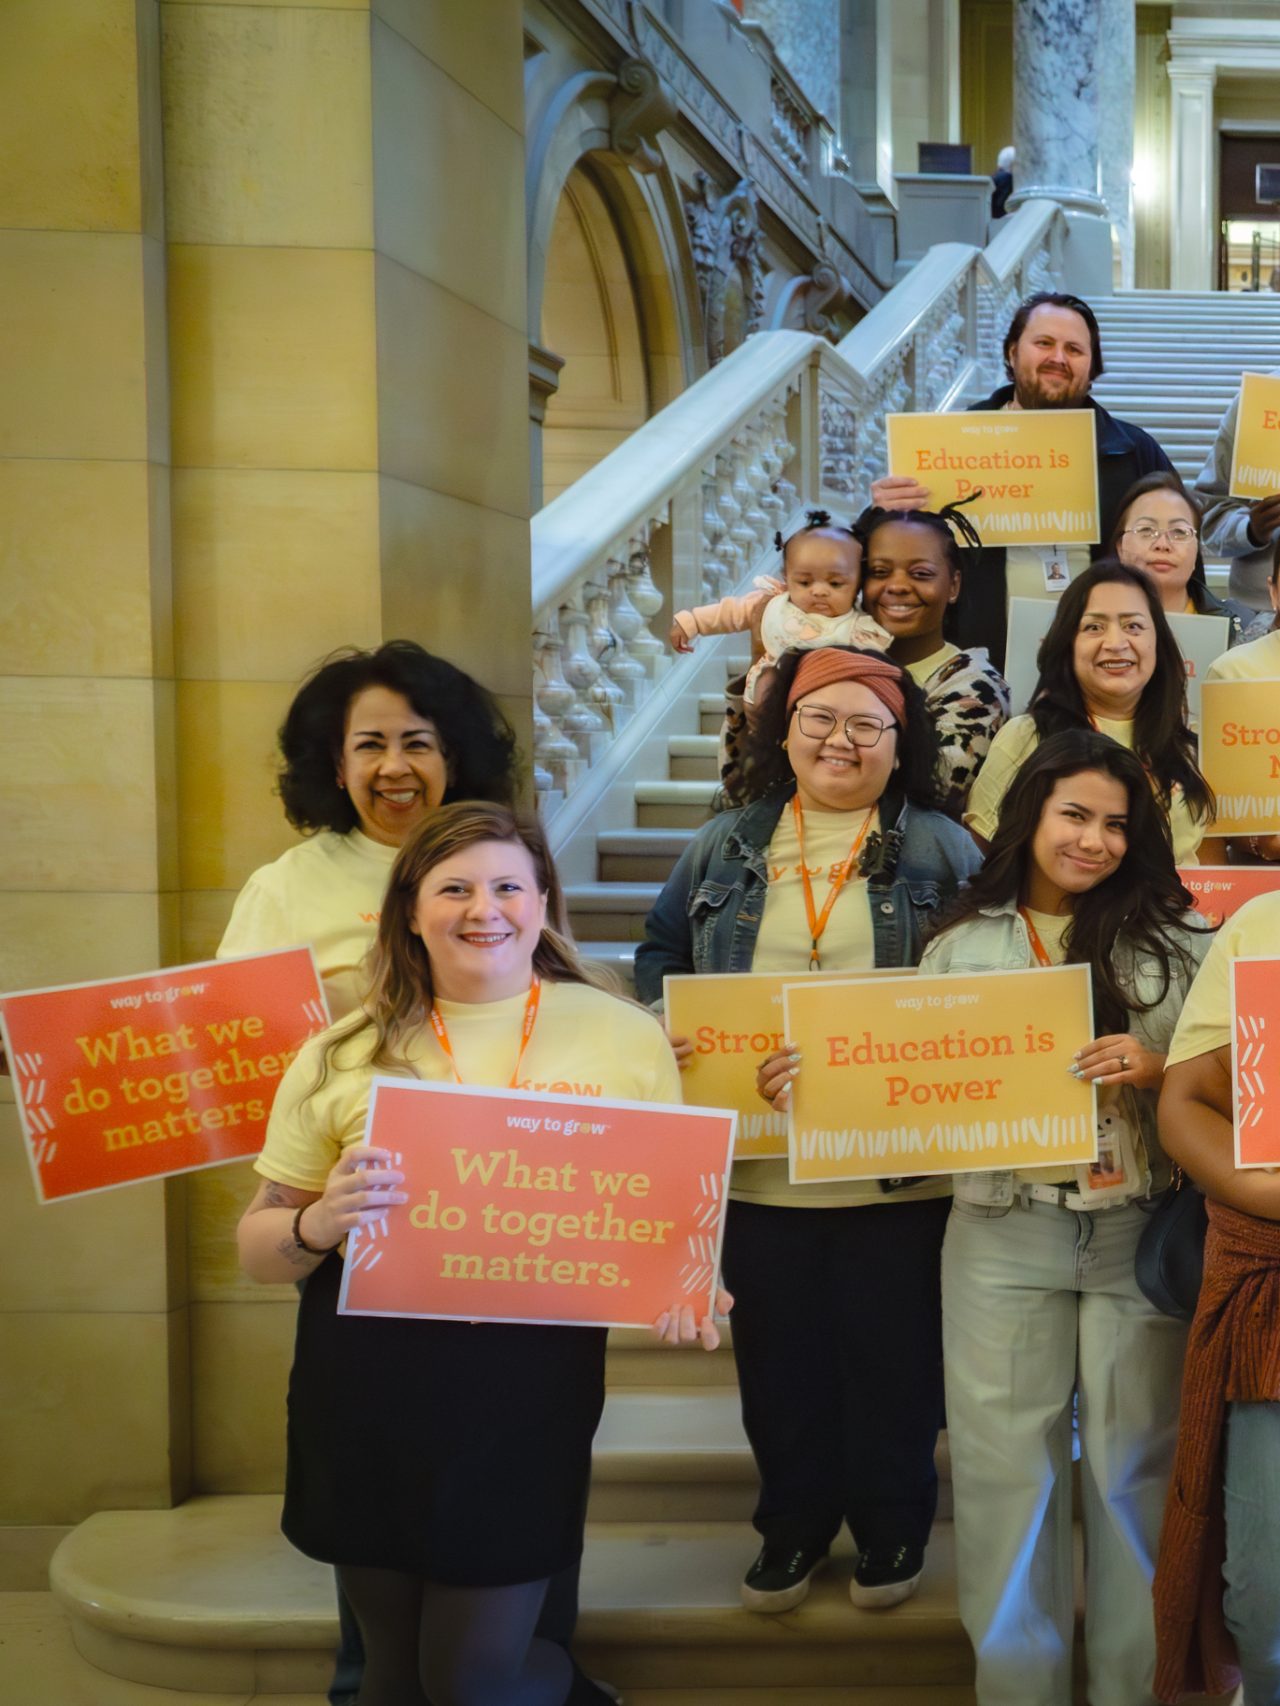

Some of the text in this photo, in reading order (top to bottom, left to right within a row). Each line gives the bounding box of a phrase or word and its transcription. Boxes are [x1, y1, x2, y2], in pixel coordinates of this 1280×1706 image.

[916, 448, 1070, 471] Education is
[956, 479, 1034, 500] Power
[1190, 881, 1201, 891] to
[1203, 881, 1232, 893] grow
[110, 982, 205, 1010] way to grow
[895, 993, 980, 1011] way to grow
[75, 1016, 265, 1069] What we
[695, 1026, 785, 1055] Stron
[826, 1024, 1056, 1067] Education is
[63, 1048, 299, 1116] do together
[885, 1076, 1002, 1108] Power
[103, 1098, 265, 1152] matters
[506, 1115, 605, 1136] way to grow
[450, 1148, 650, 1198] What we
[409, 1190, 675, 1247] do together
[440, 1251, 631, 1288] matters.
